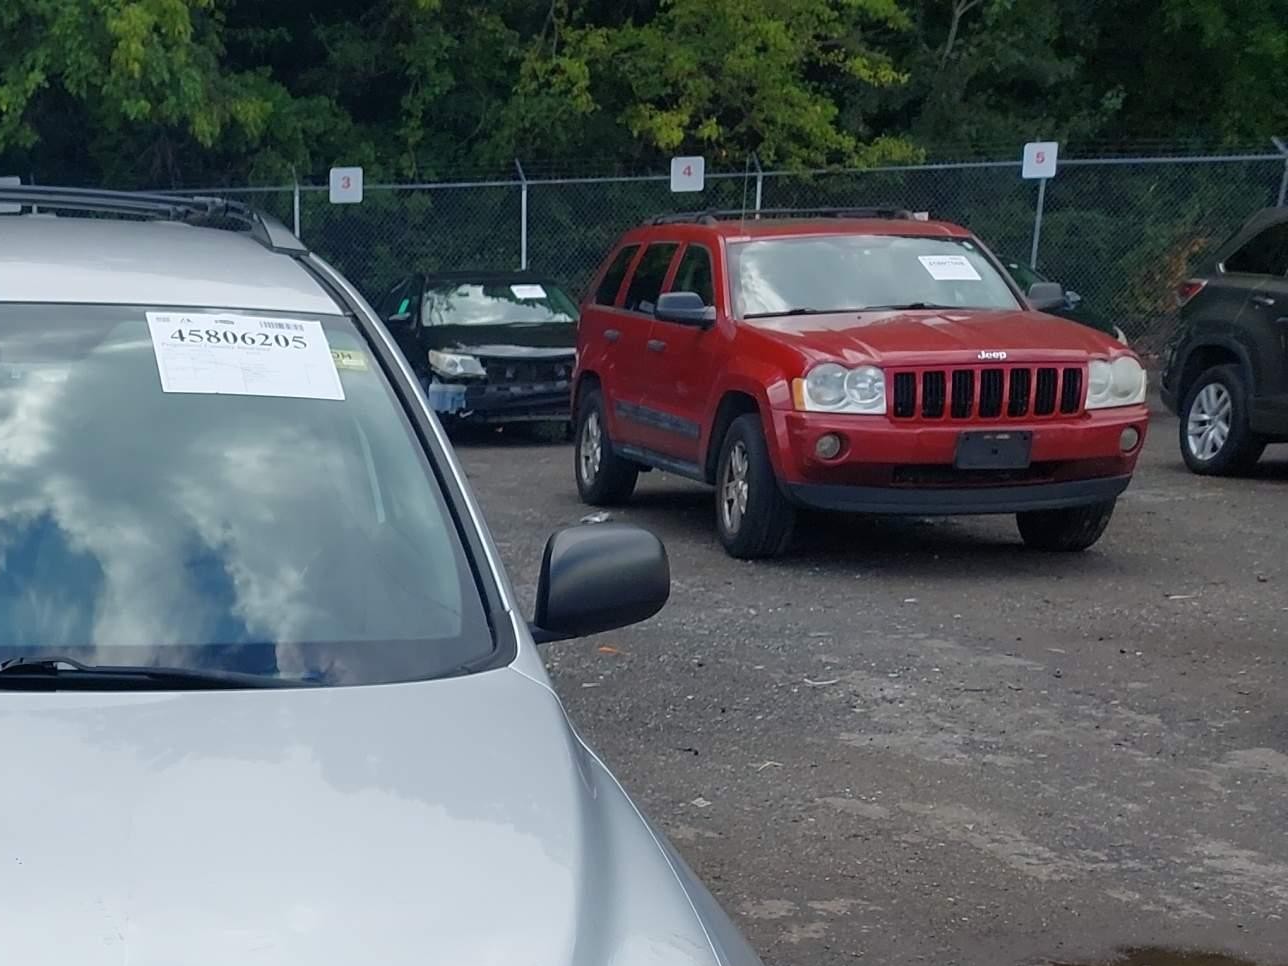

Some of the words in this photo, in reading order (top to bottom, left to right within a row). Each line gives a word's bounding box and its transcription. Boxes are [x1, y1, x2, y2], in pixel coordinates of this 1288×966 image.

[1035, 152, 1046, 164] 5
[682, 165, 692, 177] 4
[341, 175, 352, 190] 3
[170, 328, 308, 350] 45806205
[977, 350, 1007, 361] Jeep
